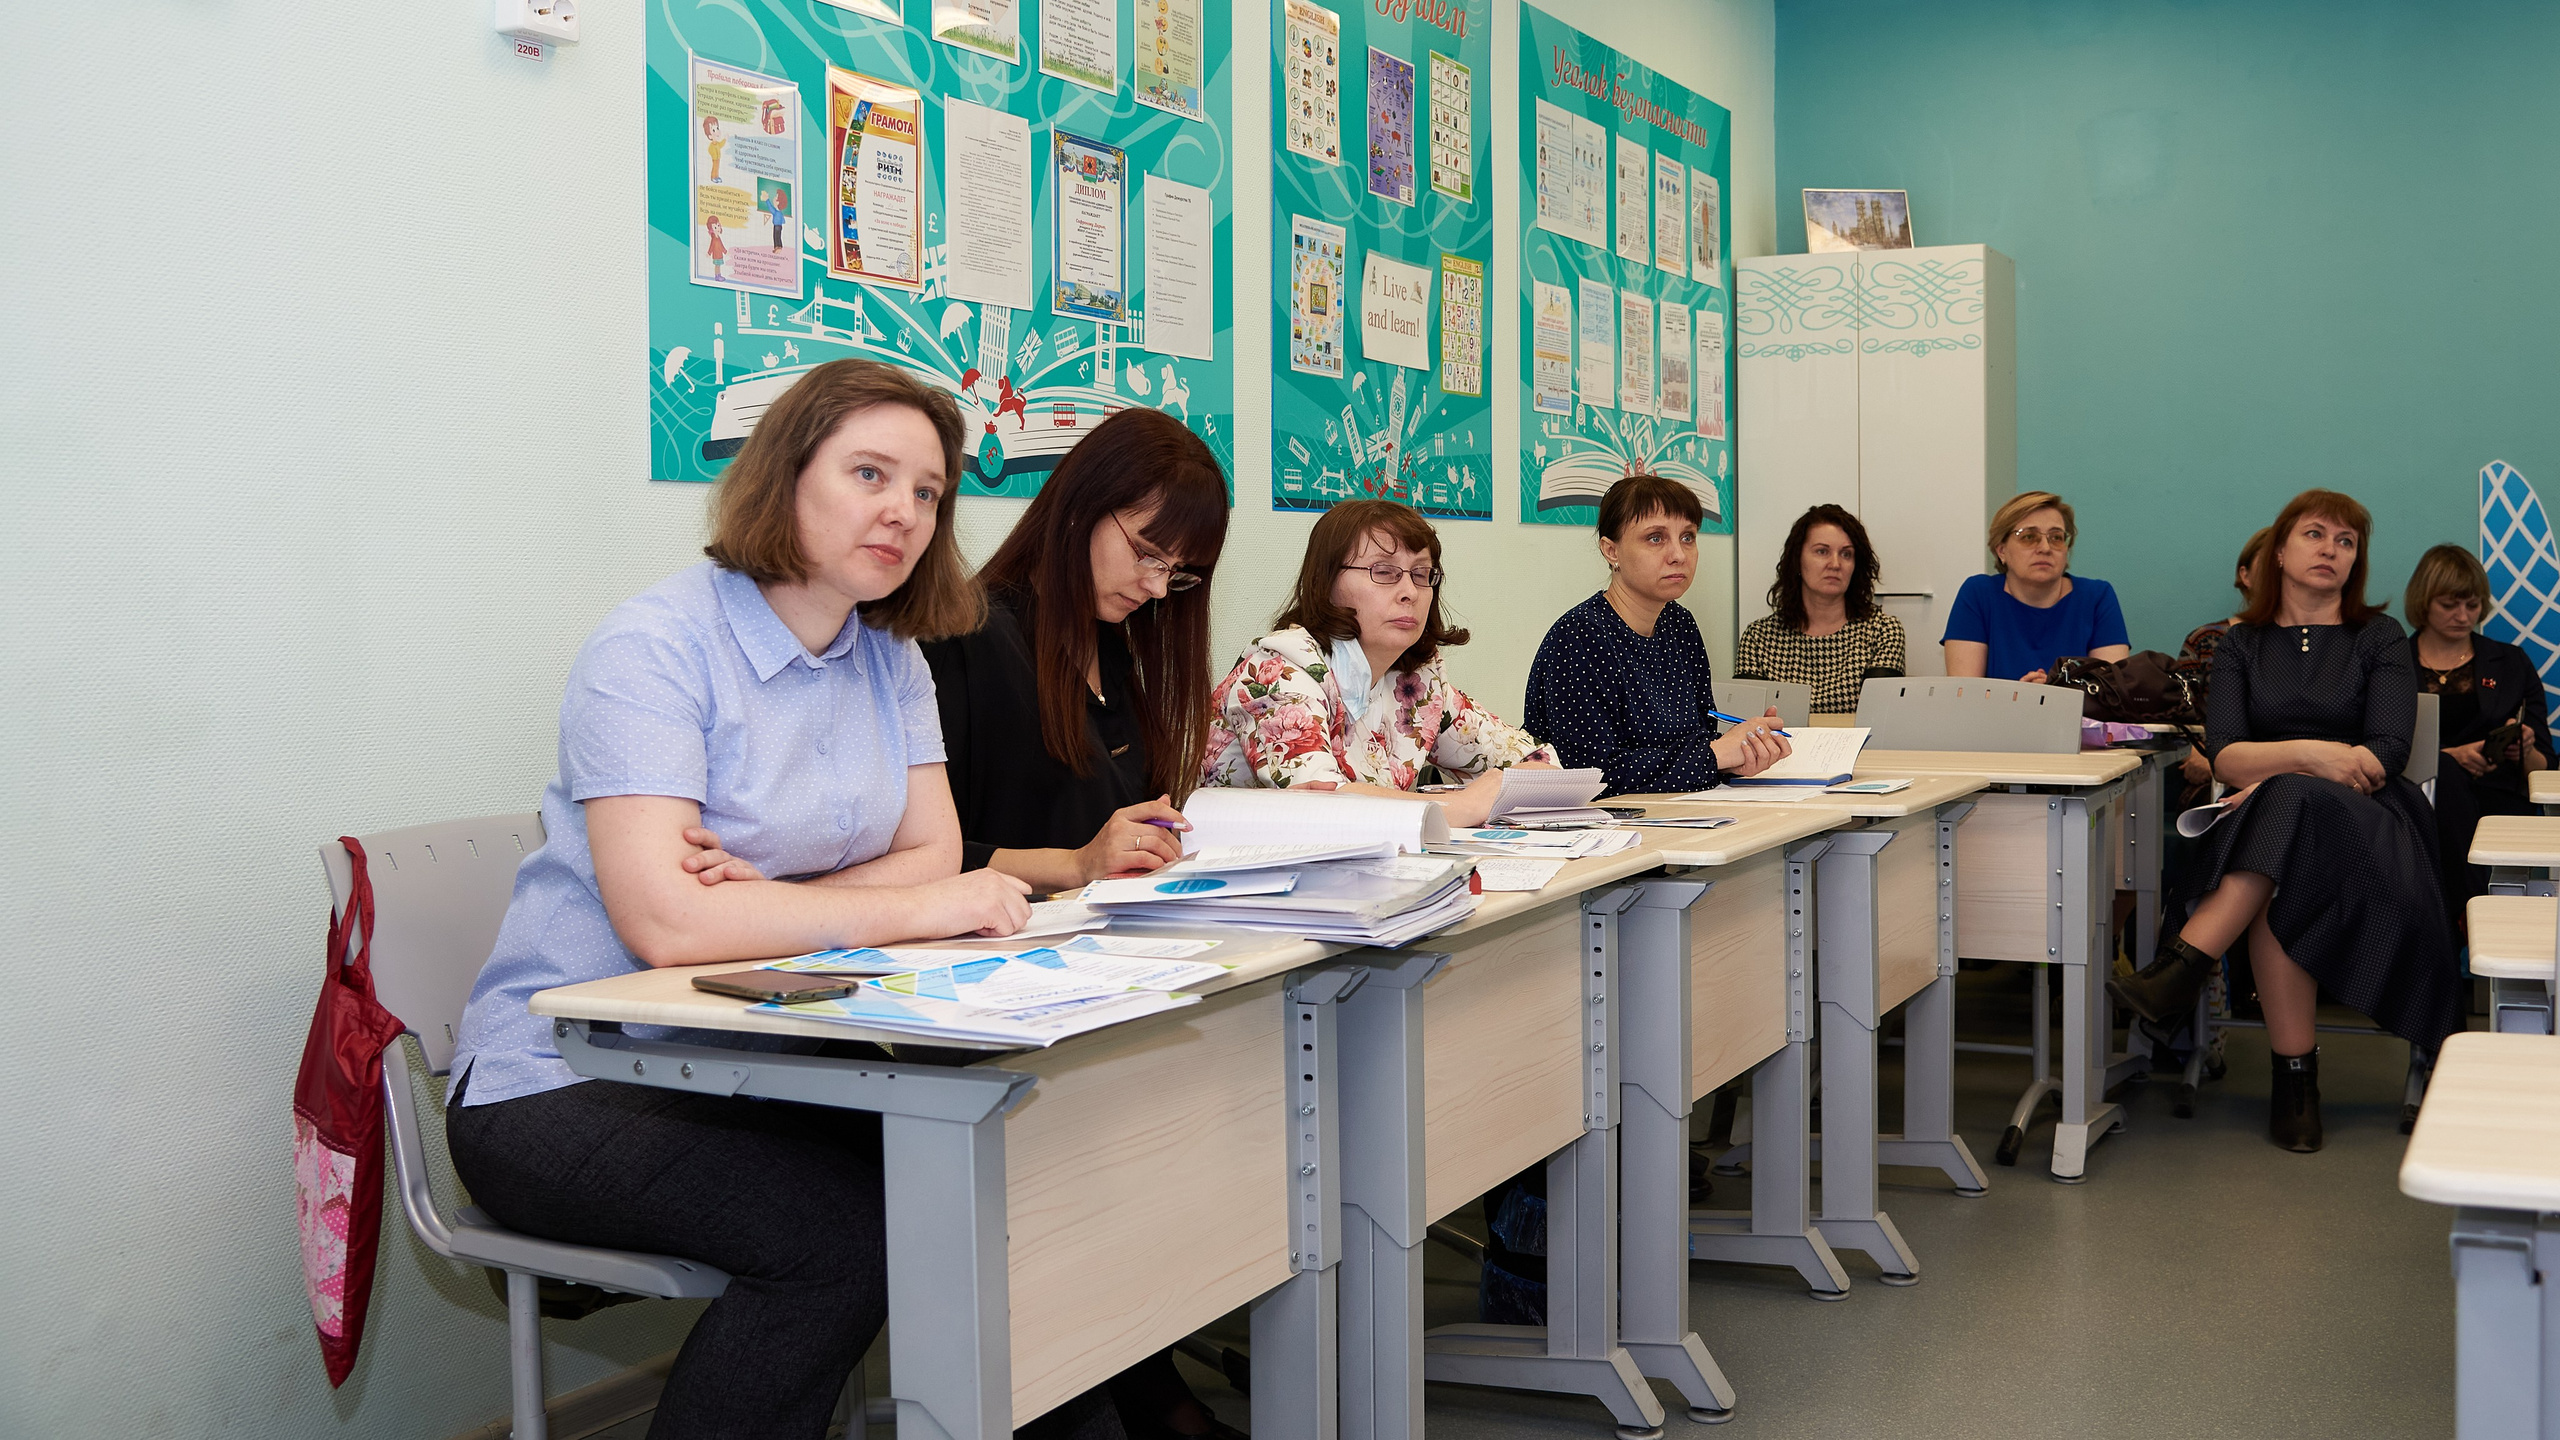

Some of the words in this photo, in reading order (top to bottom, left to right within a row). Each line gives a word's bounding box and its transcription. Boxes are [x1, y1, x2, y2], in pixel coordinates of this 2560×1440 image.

[1299, 7, 1325, 25] ENGLISH
[1551, 44, 1608, 101] Уголок
[1612, 73, 1707, 148] безопасности
[871, 112, 913, 134] ГРАМОТА
[877, 163, 902, 175] РИТМ
[1075, 184, 1106, 200] ДИПЛОМ
[1383, 275, 1406, 301] Live
[1465, 288, 1468, 299] 2
[1470, 279, 1474, 291] 3
[1457, 306, 1461, 318] 5
[1368, 309, 1387, 330] and
[1391, 310, 1419, 338] learn!
[1470, 337, 1473, 349] 9
[1444, 363, 1452, 375] 10
